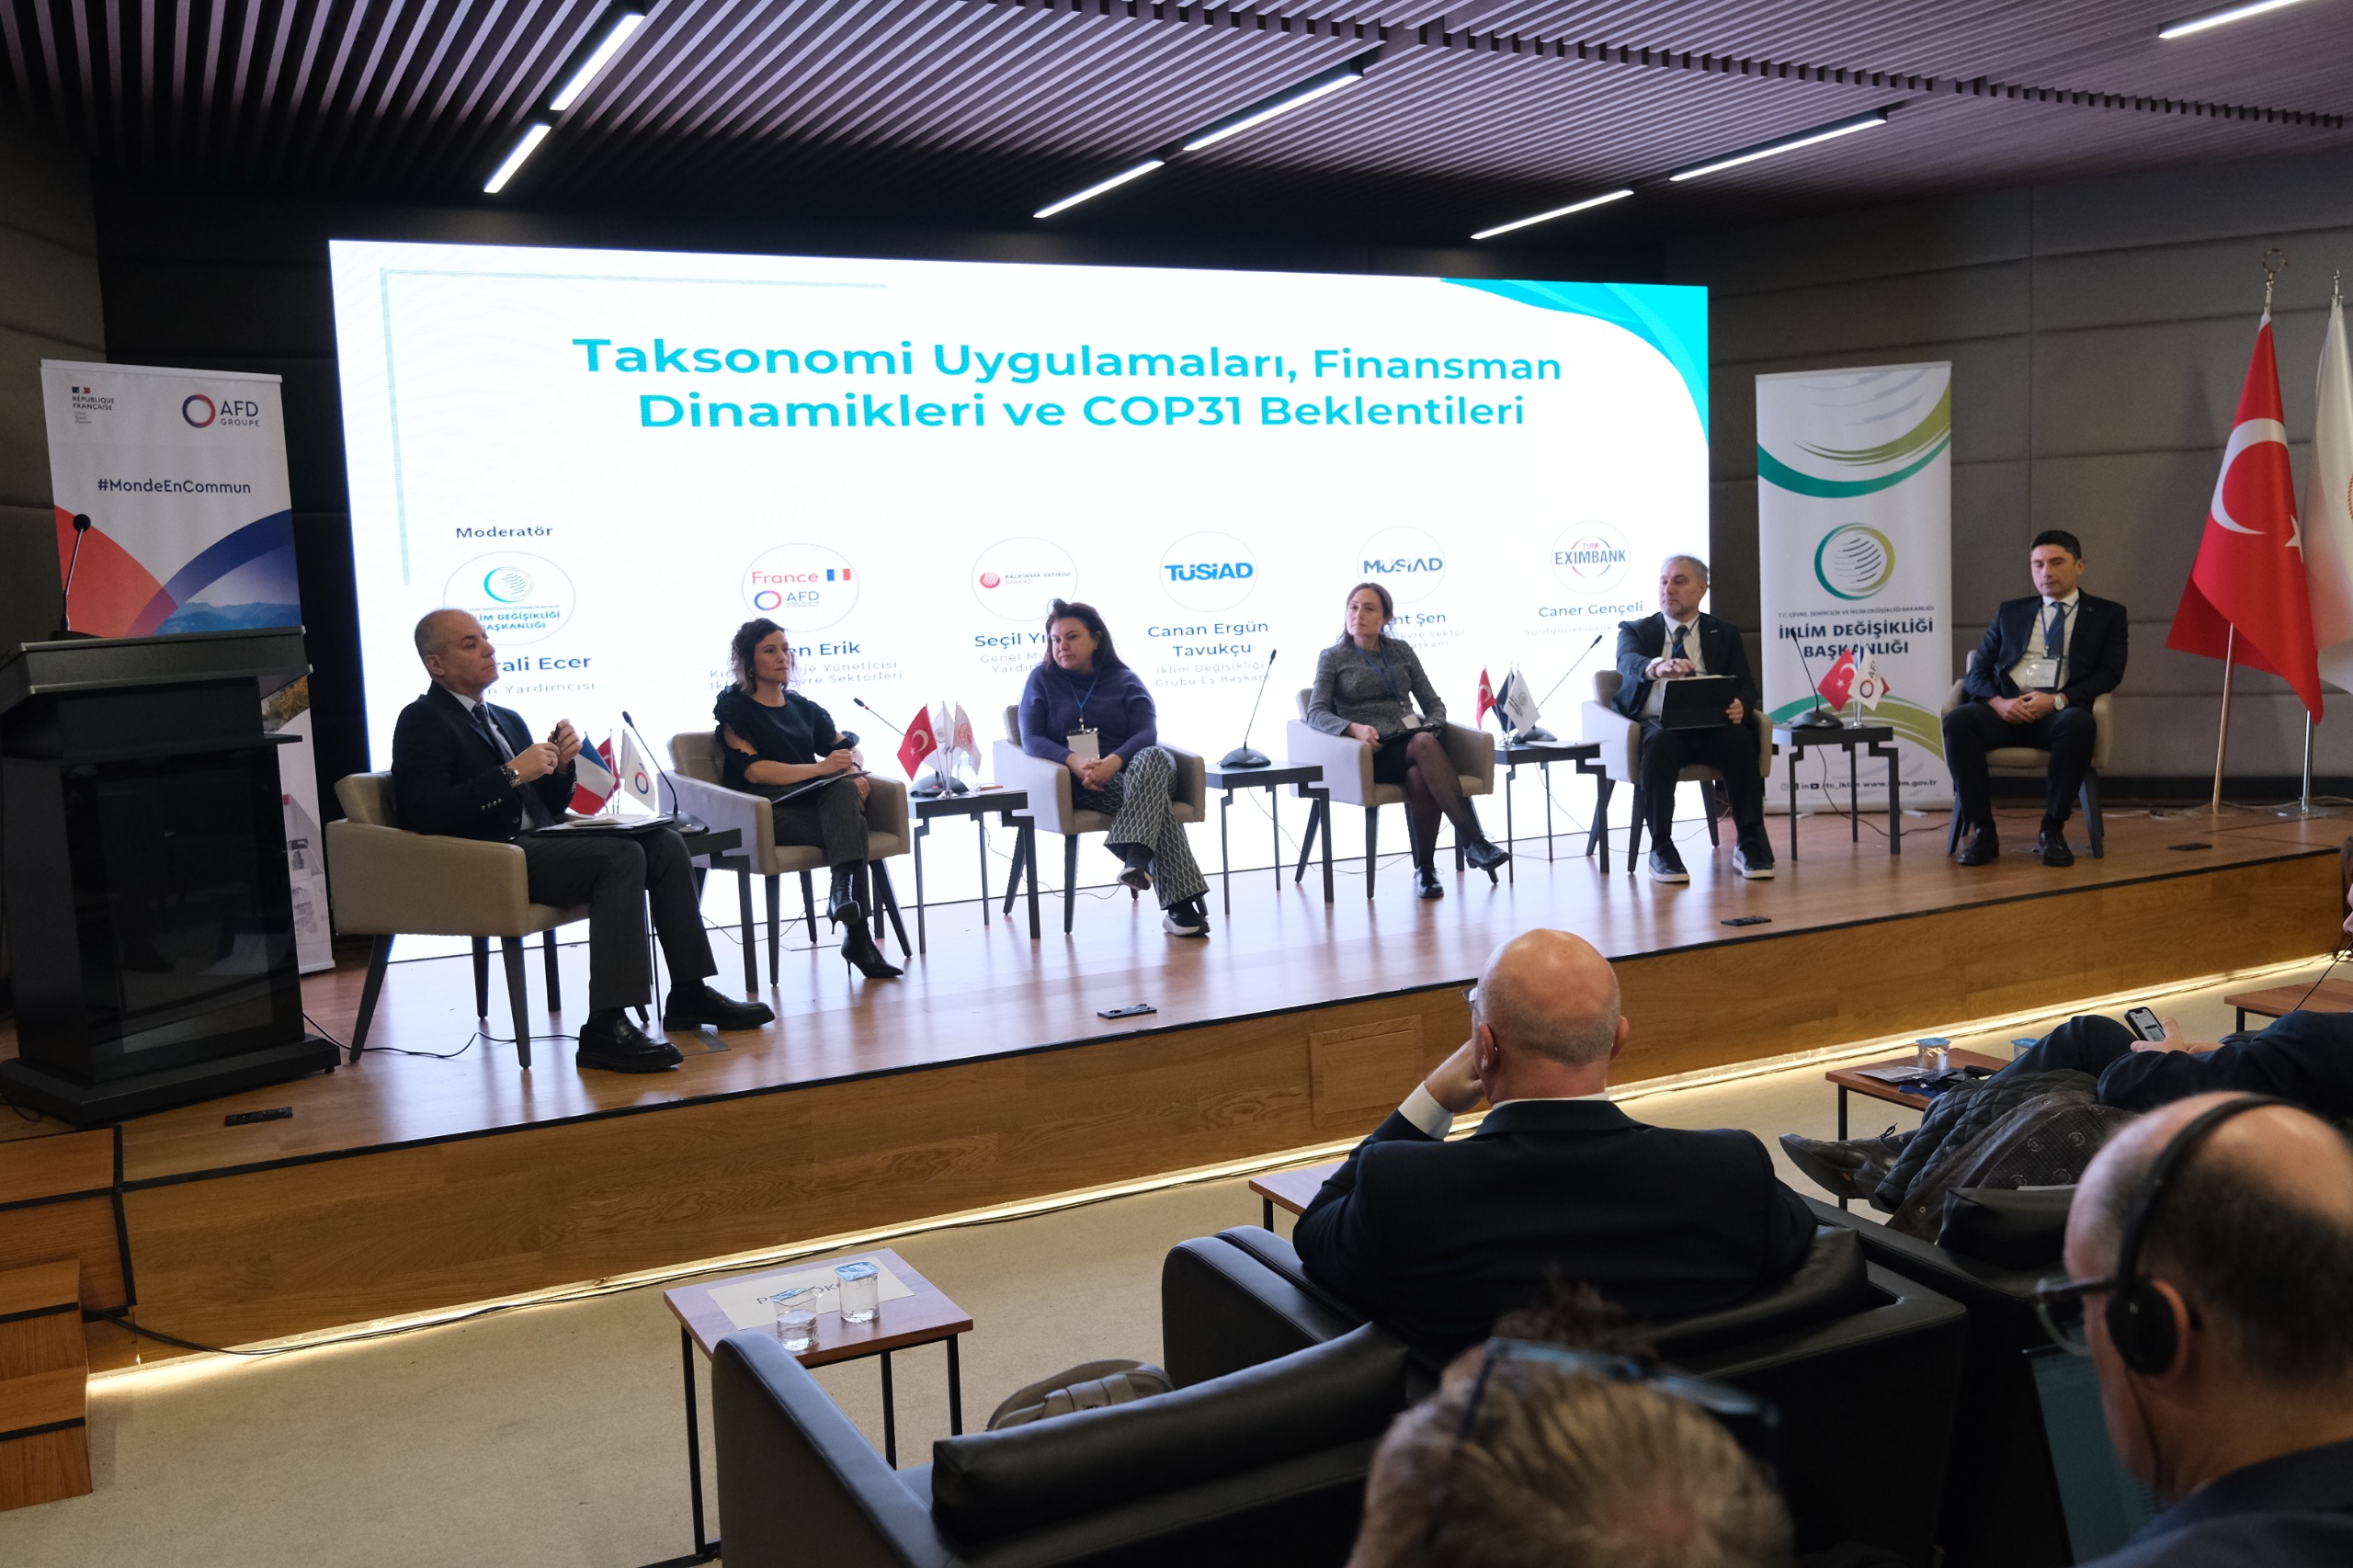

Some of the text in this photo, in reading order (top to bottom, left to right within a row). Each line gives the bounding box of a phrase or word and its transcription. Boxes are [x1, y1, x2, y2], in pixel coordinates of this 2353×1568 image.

[573, 338, 1561, 384] Taksonomi Uygulamaları, Finansman
[72, 395, 115, 404] RÉPUBLIQUE
[73, 403, 112, 411] FRANÇAISE
[221, 399, 258, 417] AFD
[640, 392, 1523, 427] Dinamikleri ve COP31 Beklentileri
[221, 418, 260, 427] GROUPE
[97, 478, 252, 494] #MondeEnCommun
[456, 526, 553, 539] Moderatör
[1554, 550, 1627, 565] EXIMBANK
[751, 571, 819, 585] France
[786, 591, 820, 602] AFD
[1539, 600, 1643, 618] Caner Gençeli
[1416, 612, 1447, 628] Şen
[1148, 620, 1268, 638] Canan Ergün
[1833, 617, 1934, 639] DEĞİŞİKLİĞİ
[974, 632, 1021, 649] Seçil
[819, 641, 861, 656] Erik
[1172, 643, 1252, 657] Tavukçu
[539, 656, 593, 671] Ecer
[505, 682, 596, 696] Yardımcısı
